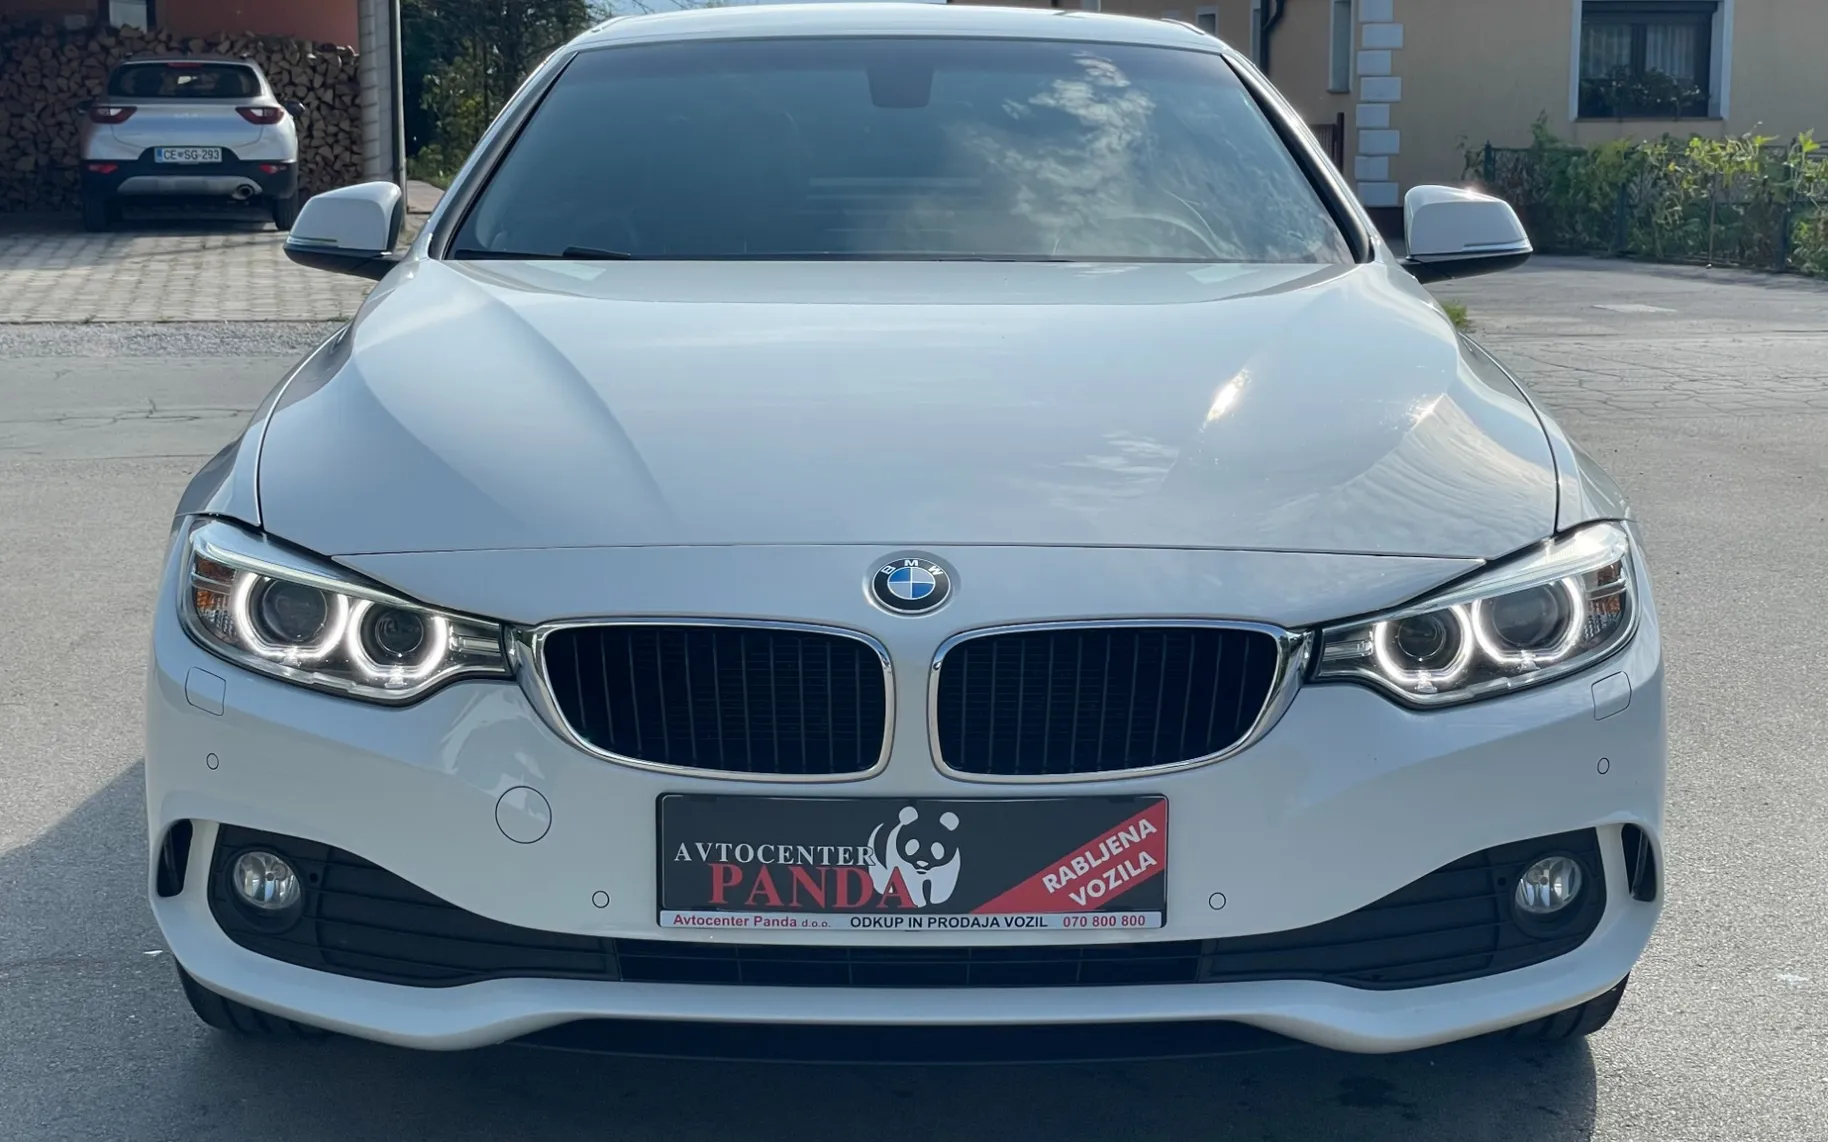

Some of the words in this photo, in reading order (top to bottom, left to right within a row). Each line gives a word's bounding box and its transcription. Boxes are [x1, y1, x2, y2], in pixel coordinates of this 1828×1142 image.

[163, 149, 177, 160] CE
[881, 559, 943, 576] BMW
[674, 842, 876, 867] AVTOCENTER
[1042, 818, 1158, 894] RABLJENA
[708, 863, 918, 909] PANDA
[1068, 850, 1158, 906] VOZILA
[673, 914, 751, 927] Avtocenter
[753, 915, 797, 928] Panda
[801, 918, 831, 929] d.o.o.
[850, 916, 904, 928] ODKUP
[908, 916, 922, 928] IN
[927, 916, 1001, 929] PRODAJA
[1004, 916, 1048, 928] VOZIL
[1063, 916, 1087, 928] 070
[1092, 915, 1116, 927] 800
[1121, 915, 1145, 927] 800
